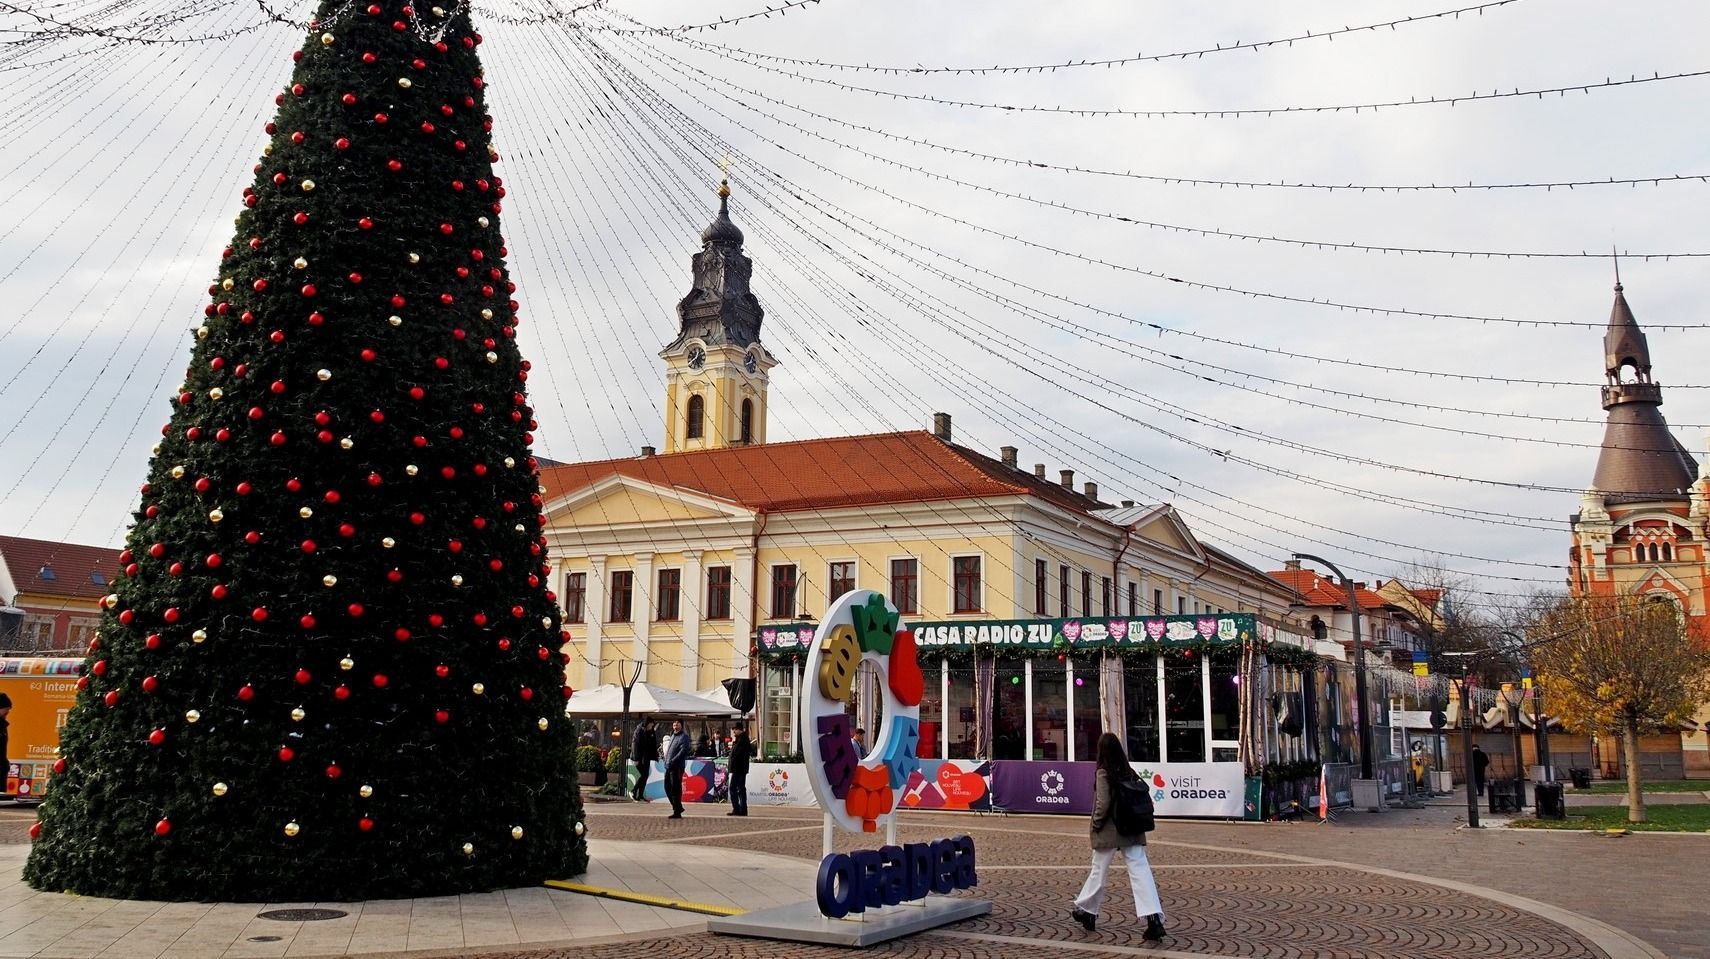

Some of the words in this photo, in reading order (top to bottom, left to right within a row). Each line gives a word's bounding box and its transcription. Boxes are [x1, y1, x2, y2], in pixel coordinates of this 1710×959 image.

[1131, 623, 1142, 634] ZU
[1220, 621, 1232, 632] ZU
[914, 626, 961, 646] CASA
[964, 625, 1025, 644] RADIO
[1027, 624, 1053, 643] ZU
[44, 682, 76, 692] Interr
